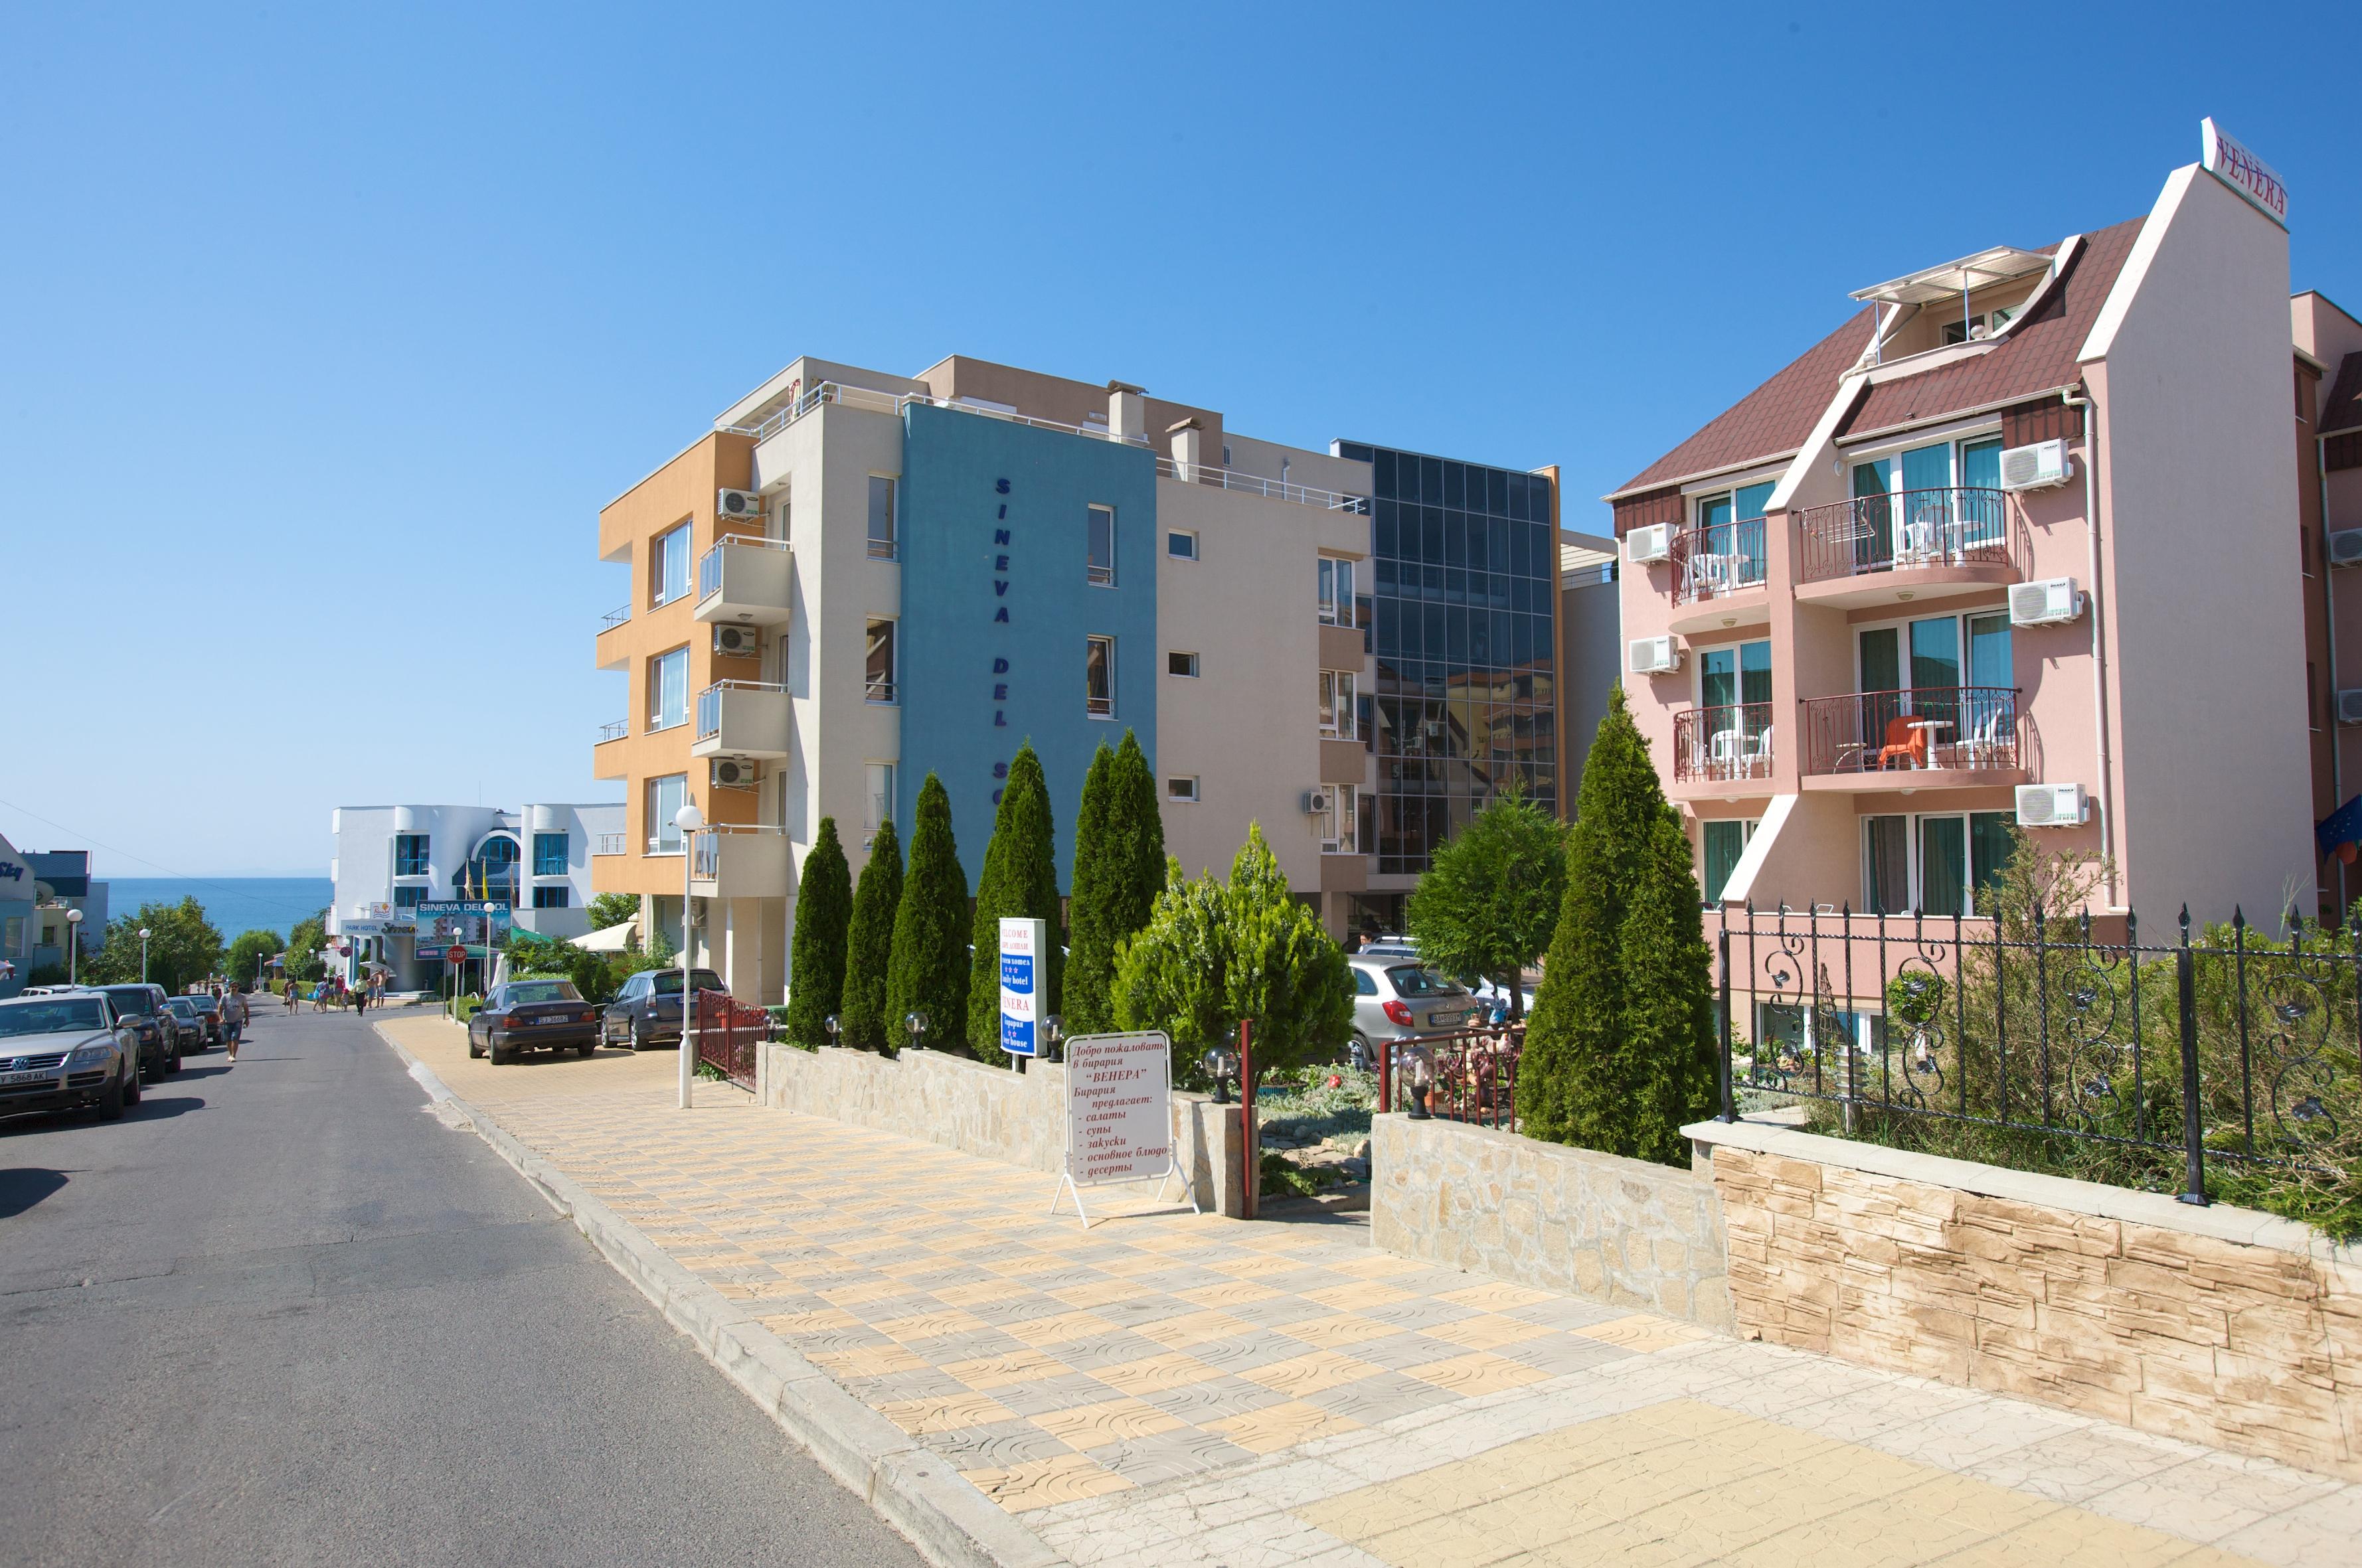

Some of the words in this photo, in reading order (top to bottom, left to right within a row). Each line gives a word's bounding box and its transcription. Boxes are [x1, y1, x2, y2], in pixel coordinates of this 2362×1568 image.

[2217, 135, 2284, 215] VENERA
[995, 478, 1011, 623] SINEVA
[993, 658, 1009, 727] DEL
[1012, 975, 1028, 986] hotel
[1010, 1036, 1028, 1048] house
[1072, 1046, 1102, 1058] Добро
[1104, 1042, 1165, 1054] пожаловать
[1073, 1059, 1078, 1069] в
[1082, 1058, 1123, 1069] бирария
[11, 1074, 32, 1083] 5868
[1074, 1087, 1116, 1098] Бирария
[1092, 1096, 1152, 1111] предлагает:
[1086, 1111, 1126, 1122] салаты
[1086, 1126, 1111, 1138] супы
[1087, 1136, 1126, 1149] закуски
[1088, 1150, 1132, 1162] основное
[1136, 1146, 1167, 1158] блюдо
[1088, 1164, 1132, 1178] десерты
